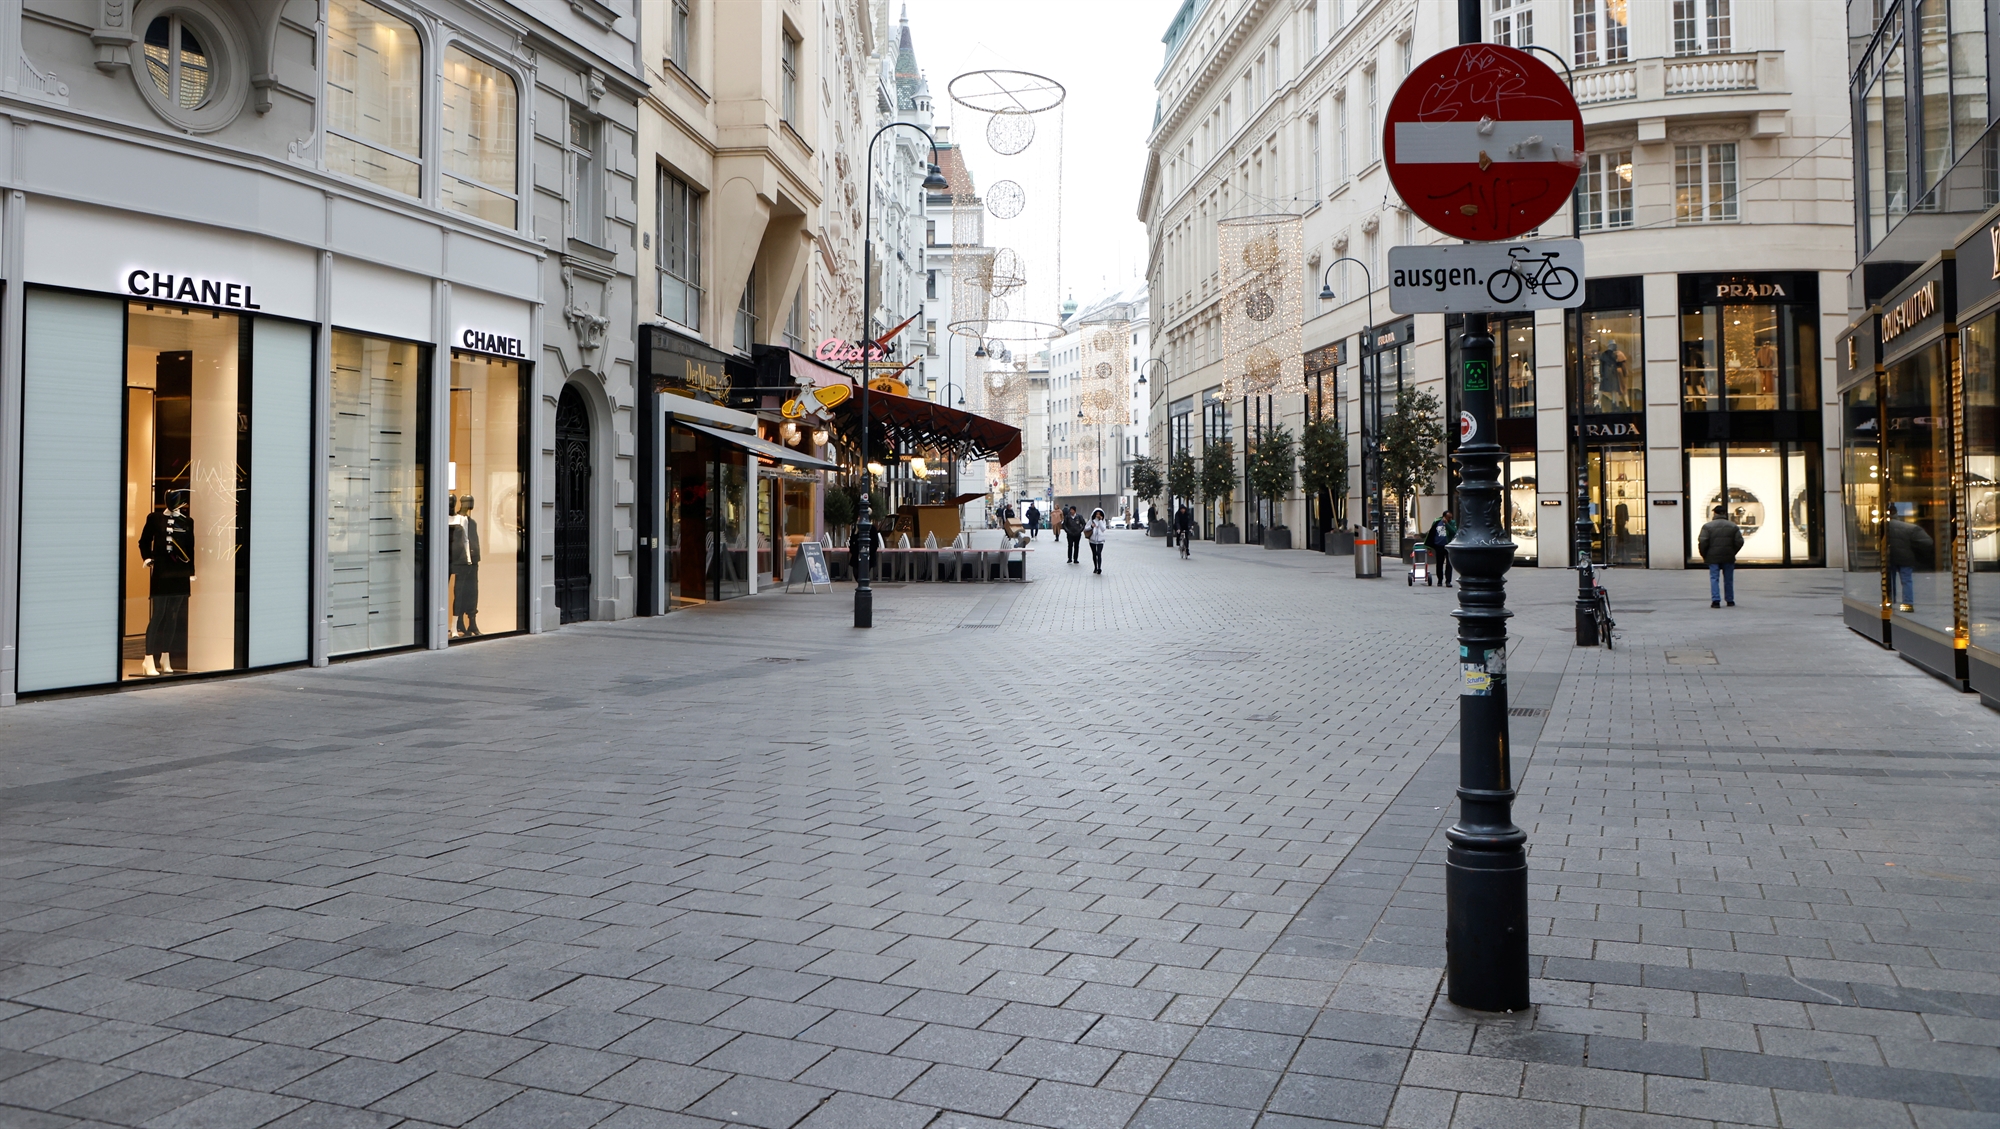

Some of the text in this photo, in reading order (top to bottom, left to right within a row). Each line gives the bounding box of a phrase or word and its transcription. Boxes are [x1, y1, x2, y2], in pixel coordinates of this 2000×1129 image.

[128, 269, 260, 310] CHANEL
[1394, 265, 1484, 293] ausgen.
[1716, 283, 1786, 298] PRADA
[1881, 280, 1935, 344] LOUIS VUITTON
[463, 328, 525, 358] CHANEL
[686, 359, 717, 391] Der Mann
